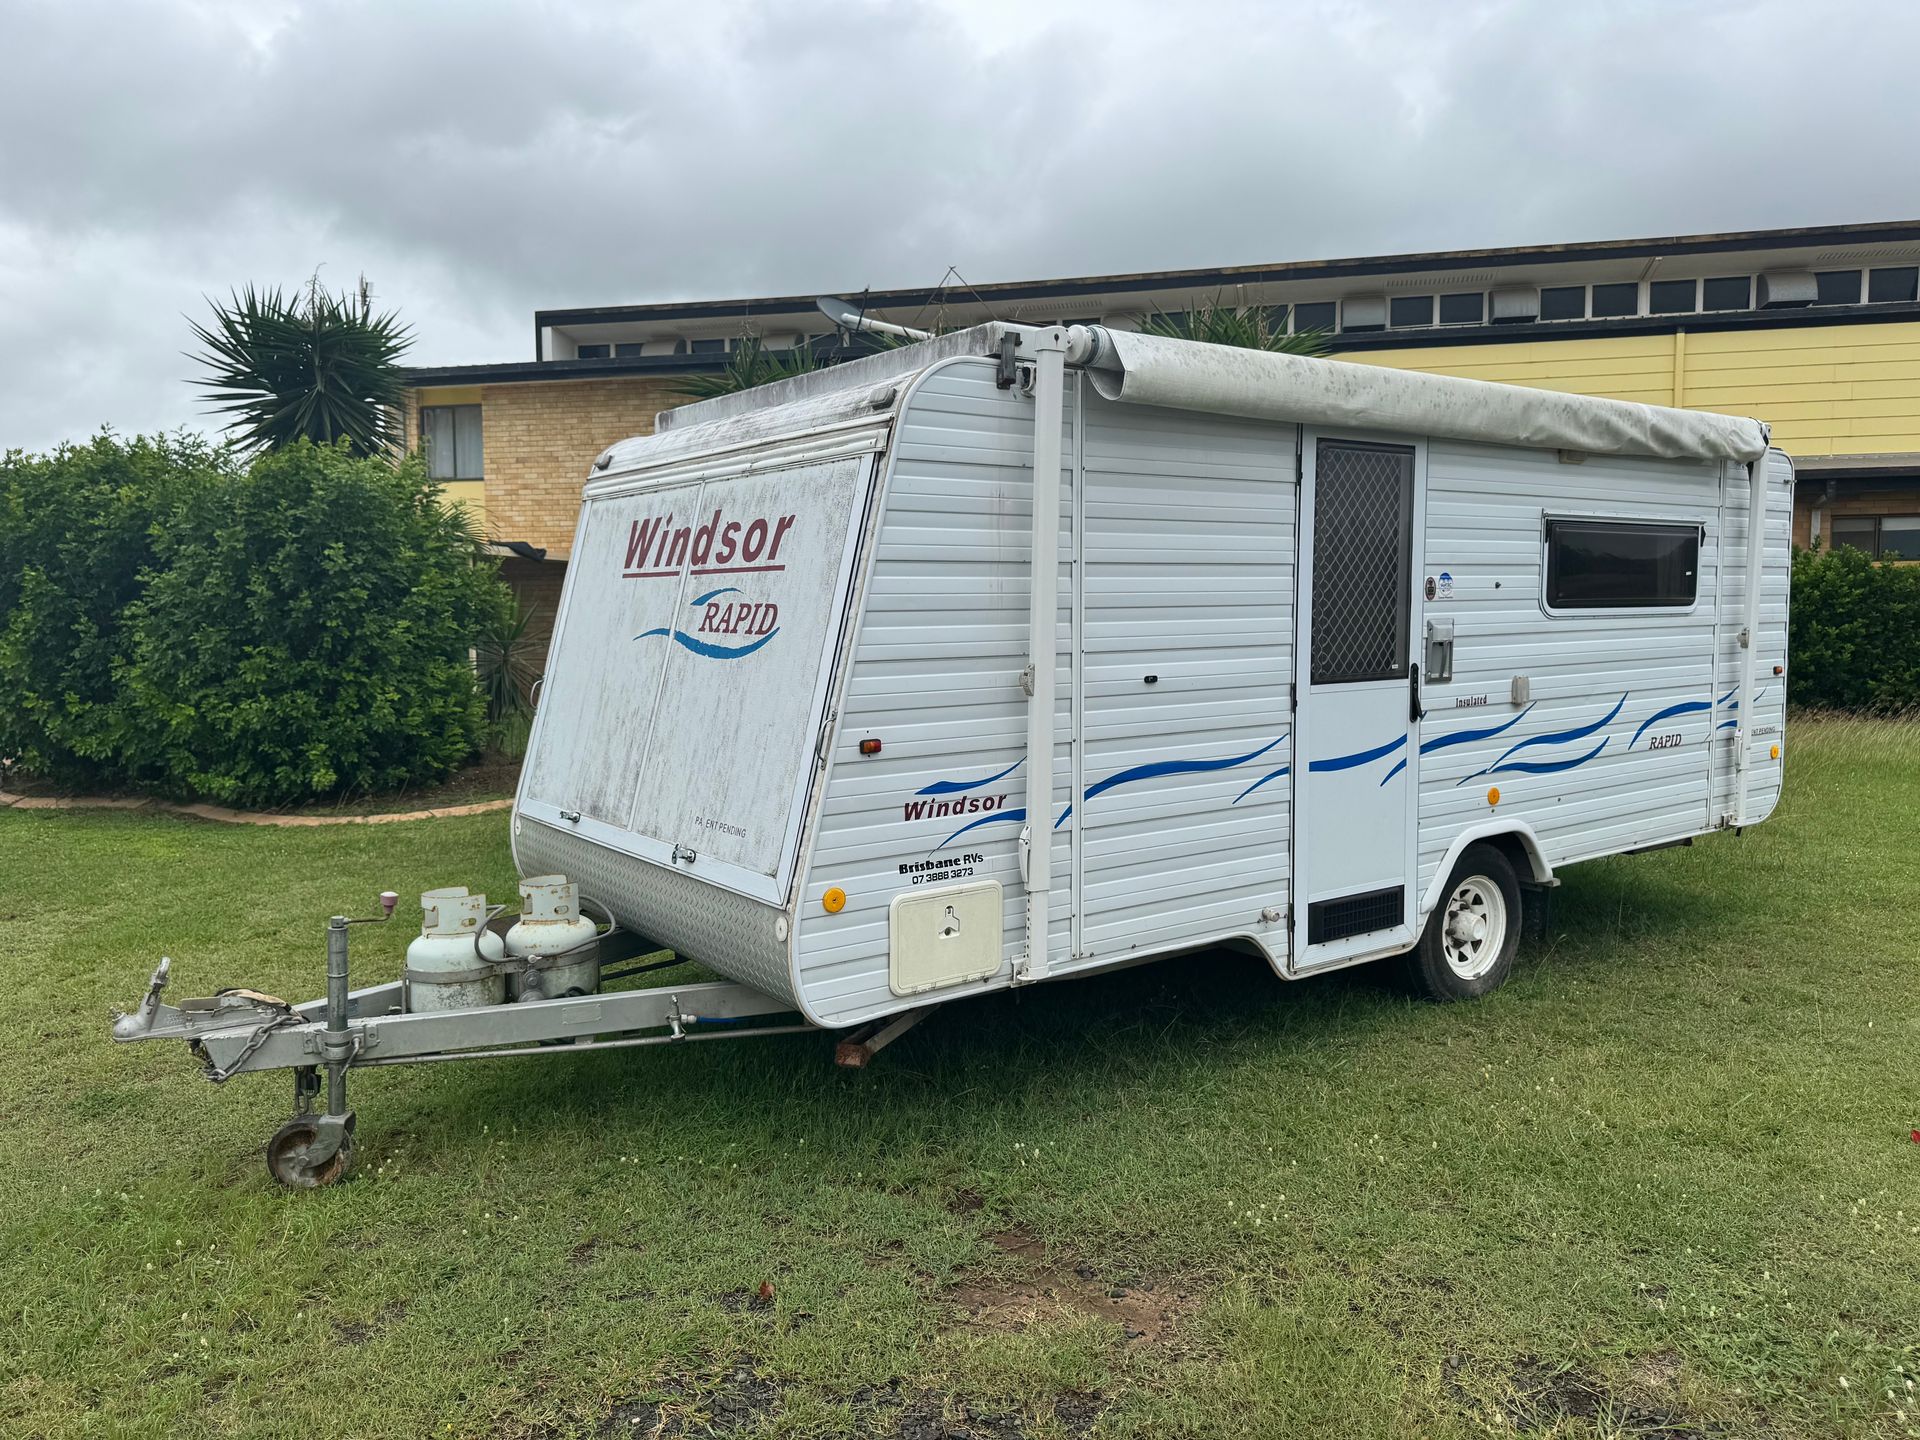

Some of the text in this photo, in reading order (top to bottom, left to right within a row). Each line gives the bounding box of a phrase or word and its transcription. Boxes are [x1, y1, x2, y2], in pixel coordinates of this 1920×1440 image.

[623, 509, 796, 569] Windsor
[698, 602, 778, 635] RAPID
[1455, 694, 1487, 708] Insulated
[1649, 733, 1682, 750] RAPID
[904, 794, 1007, 821] Windsor
[694, 816, 746, 838] PAENT PENDING
[899, 852, 984, 875] Brisbane RVs
[912, 867, 974, 885] 07 3888 3273
